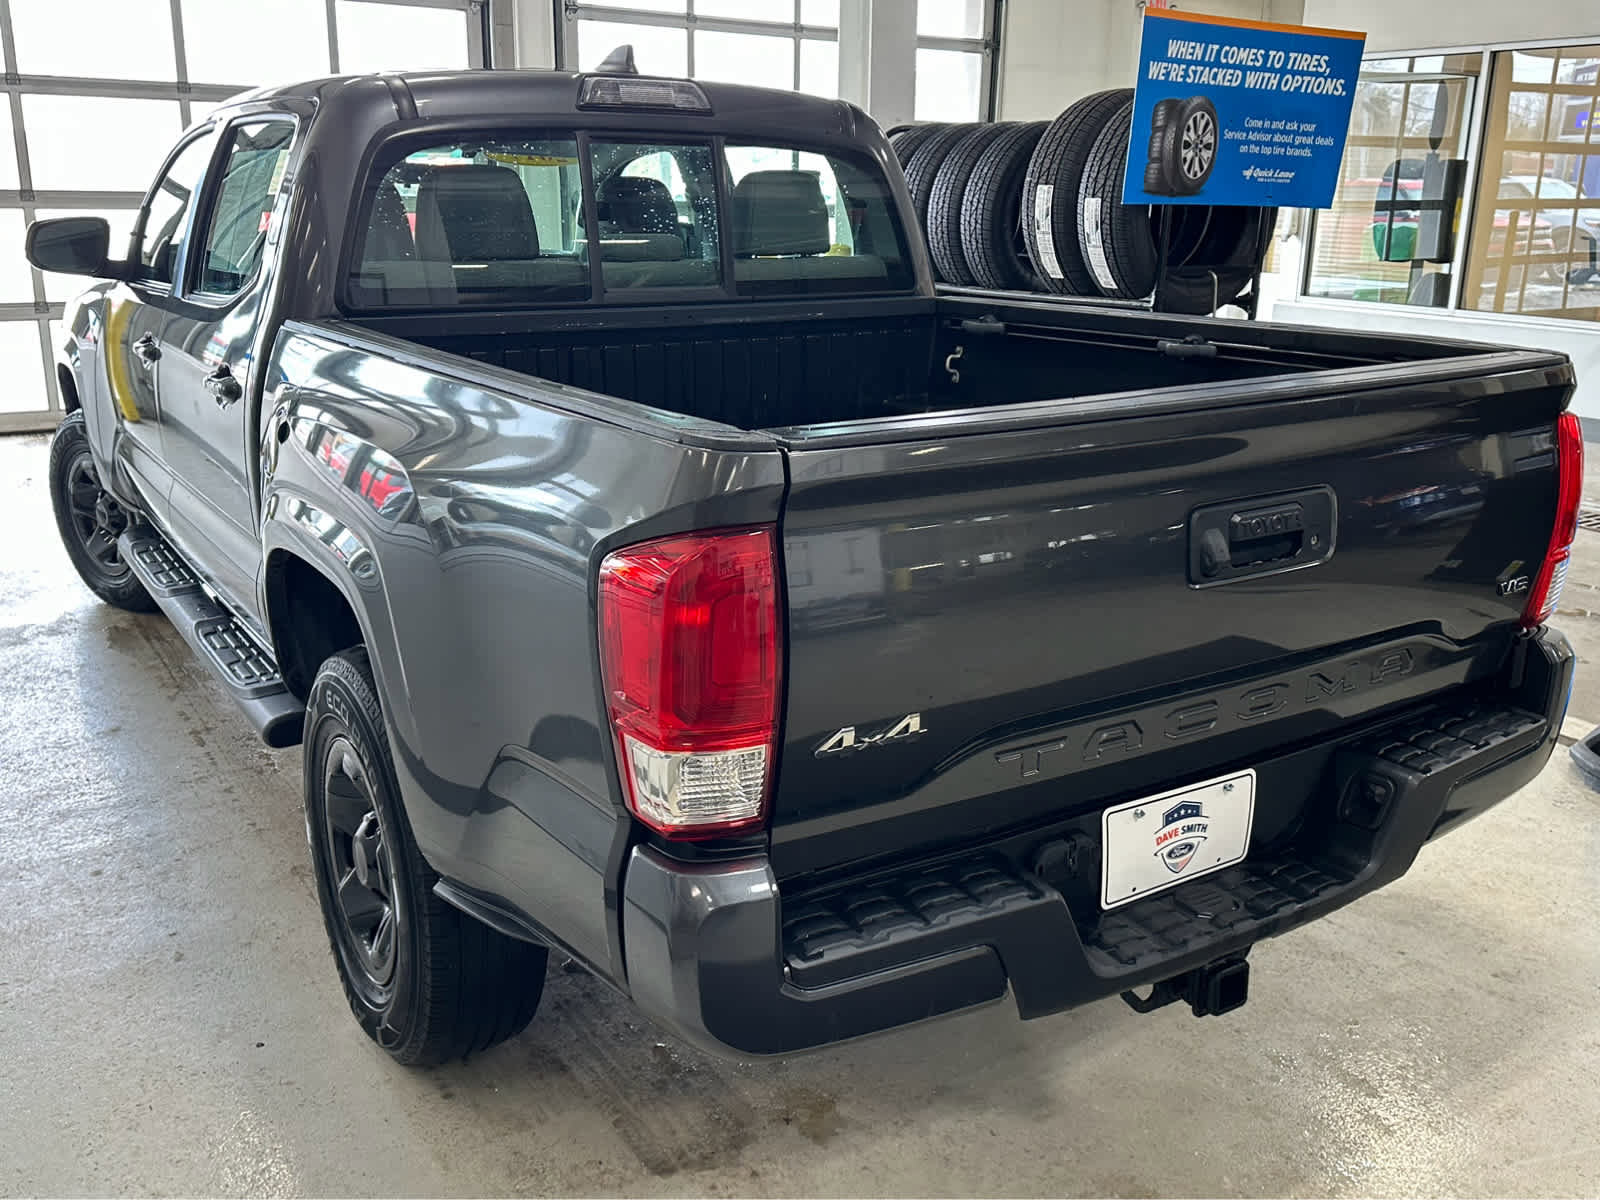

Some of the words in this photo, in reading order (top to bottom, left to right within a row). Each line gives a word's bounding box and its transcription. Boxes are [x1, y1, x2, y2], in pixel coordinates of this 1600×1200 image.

[1168, 40, 1204, 60] WHEN
[1205, 44, 1219, 62] IT
[1220, 46, 1265, 67] COMES
[1267, 50, 1284, 69] TO
[1286, 52, 1331, 76] TIRES,
[1148, 61, 1185, 82] WE'RE
[1186, 66, 1242, 87] STACKED
[1244, 71, 1279, 91] WITH
[1280, 74, 1346, 96] OPTIONS.
[1244, 117, 1263, 128] Come
[1264, 118, 1270, 128] in
[1271, 119, 1285, 130] and
[1286, 121, 1298, 131] ask
[1299, 123, 1317, 133] your
[1223, 129, 1246, 140] Service
[1247, 131, 1272, 142] Advisor
[1272, 132, 1293, 143] about
[1294, 135, 1314, 145] great
[1315, 135, 1334, 146] deals
[1240, 145, 1248, 153] on
[1249, 144, 1260, 154] the
[1261, 145, 1272, 156] top
[1273, 145, 1285, 155] tire
[1286, 145, 1313, 157] brands.
[1253, 168, 1274, 178] Quick
[995, 647, 1415, 777] TACOMA
[1155, 827, 1180, 846] DAVE
[1180, 823, 1208, 835] SMITH
